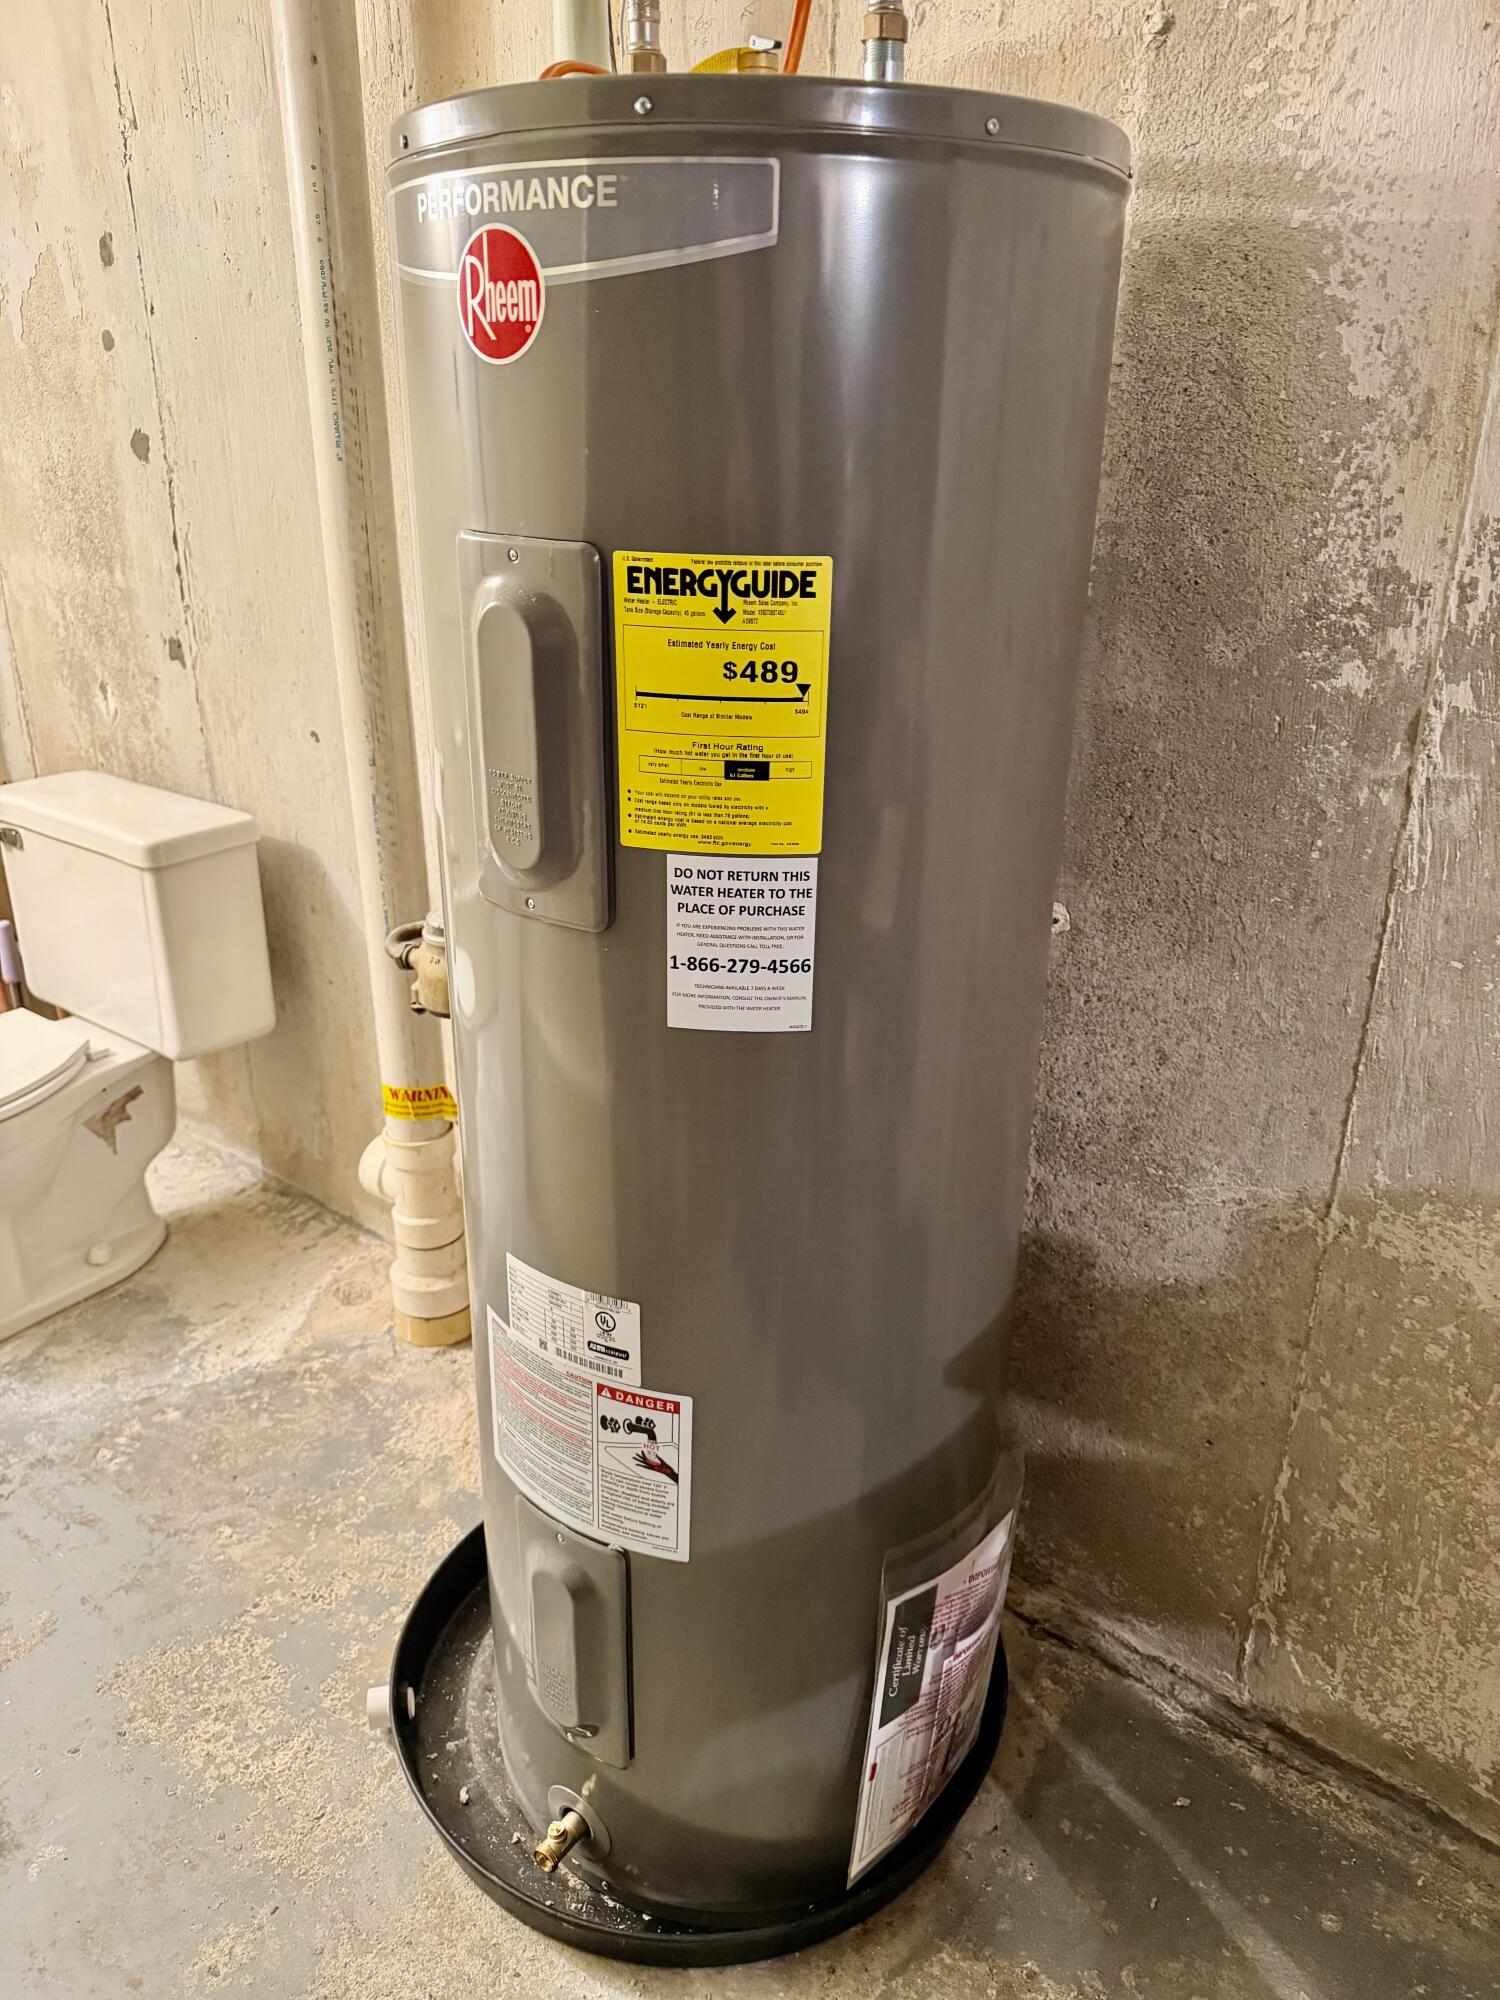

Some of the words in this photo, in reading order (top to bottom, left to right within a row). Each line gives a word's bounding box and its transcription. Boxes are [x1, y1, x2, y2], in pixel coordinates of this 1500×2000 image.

[417, 175, 618, 223] PERFORMANCE
[466, 232, 537, 340] Rheem
[627, 566, 816, 599] ENERGYGUIDE
[668, 639, 702, 648] Estimated
[706, 641, 729, 650] Yearly
[732, 642, 757, 651] Energy
[760, 642, 776, 650] Cost
[723, 660, 798, 683] $489
[737, 744, 763, 752] Rating
[674, 868, 693, 878] DO
[697, 869, 724, 880] NOT
[728, 871, 778, 881] RETURN
[782, 871, 810, 881] THIS
[671, 884, 714, 897] WATER
[718, 888, 764, 898] HEATER
[769, 889, 785, 898] TO
[789, 888, 812, 898] THE
[678, 902, 715, 914] PLACE
[719, 905, 735, 915] OF
[739, 906, 805, 916] PURCHASE
[670, 955, 811, 973] 1-866-279-4566
[390, 1086, 449, 1101] WARNIN
[600, 1315, 611, 1328] UL
[566, 1370, 592, 1385] CAUTION
[616, 1392, 674, 1412] DANGER
[889, 1641, 905, 1697] Certificate
[898, 1627, 908, 1637] of
[902, 1635, 916, 1676] Limited
